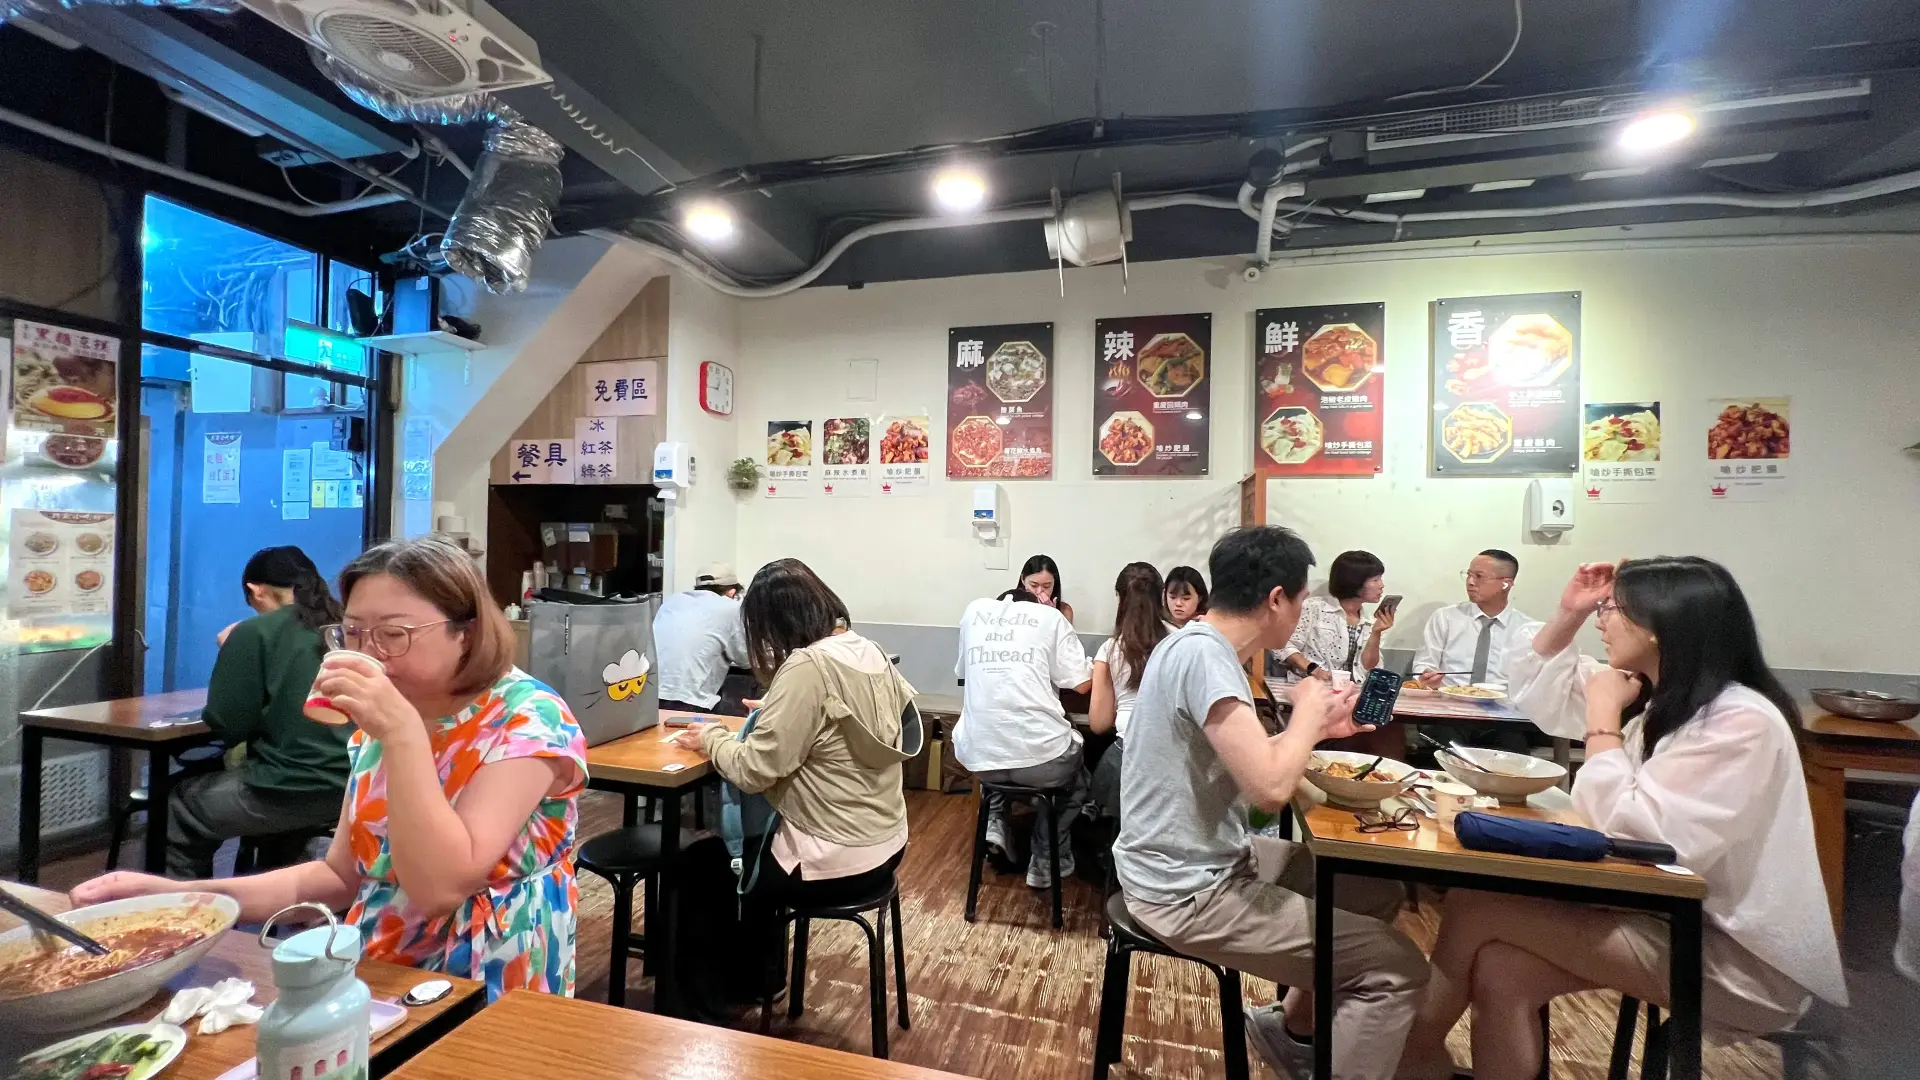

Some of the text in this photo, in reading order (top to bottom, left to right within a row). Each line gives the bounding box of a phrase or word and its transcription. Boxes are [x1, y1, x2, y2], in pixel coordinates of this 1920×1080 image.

[1264, 321, 1299, 353] 鮮
[1448, 311, 1487, 347] 香
[956, 339, 985, 368] 麻
[1103, 331, 1134, 361] 辣
[594, 378, 648, 402] 免費區
[589, 420, 605, 432] 冰
[517, 443, 567, 467] 餐具
[580, 441, 613, 455] 紅茶
[580, 464, 613, 478] 綠茶
[972, 611, 1039, 628] Needle
[985, 629, 1015, 642] and
[967, 645, 1035, 666] Thread
